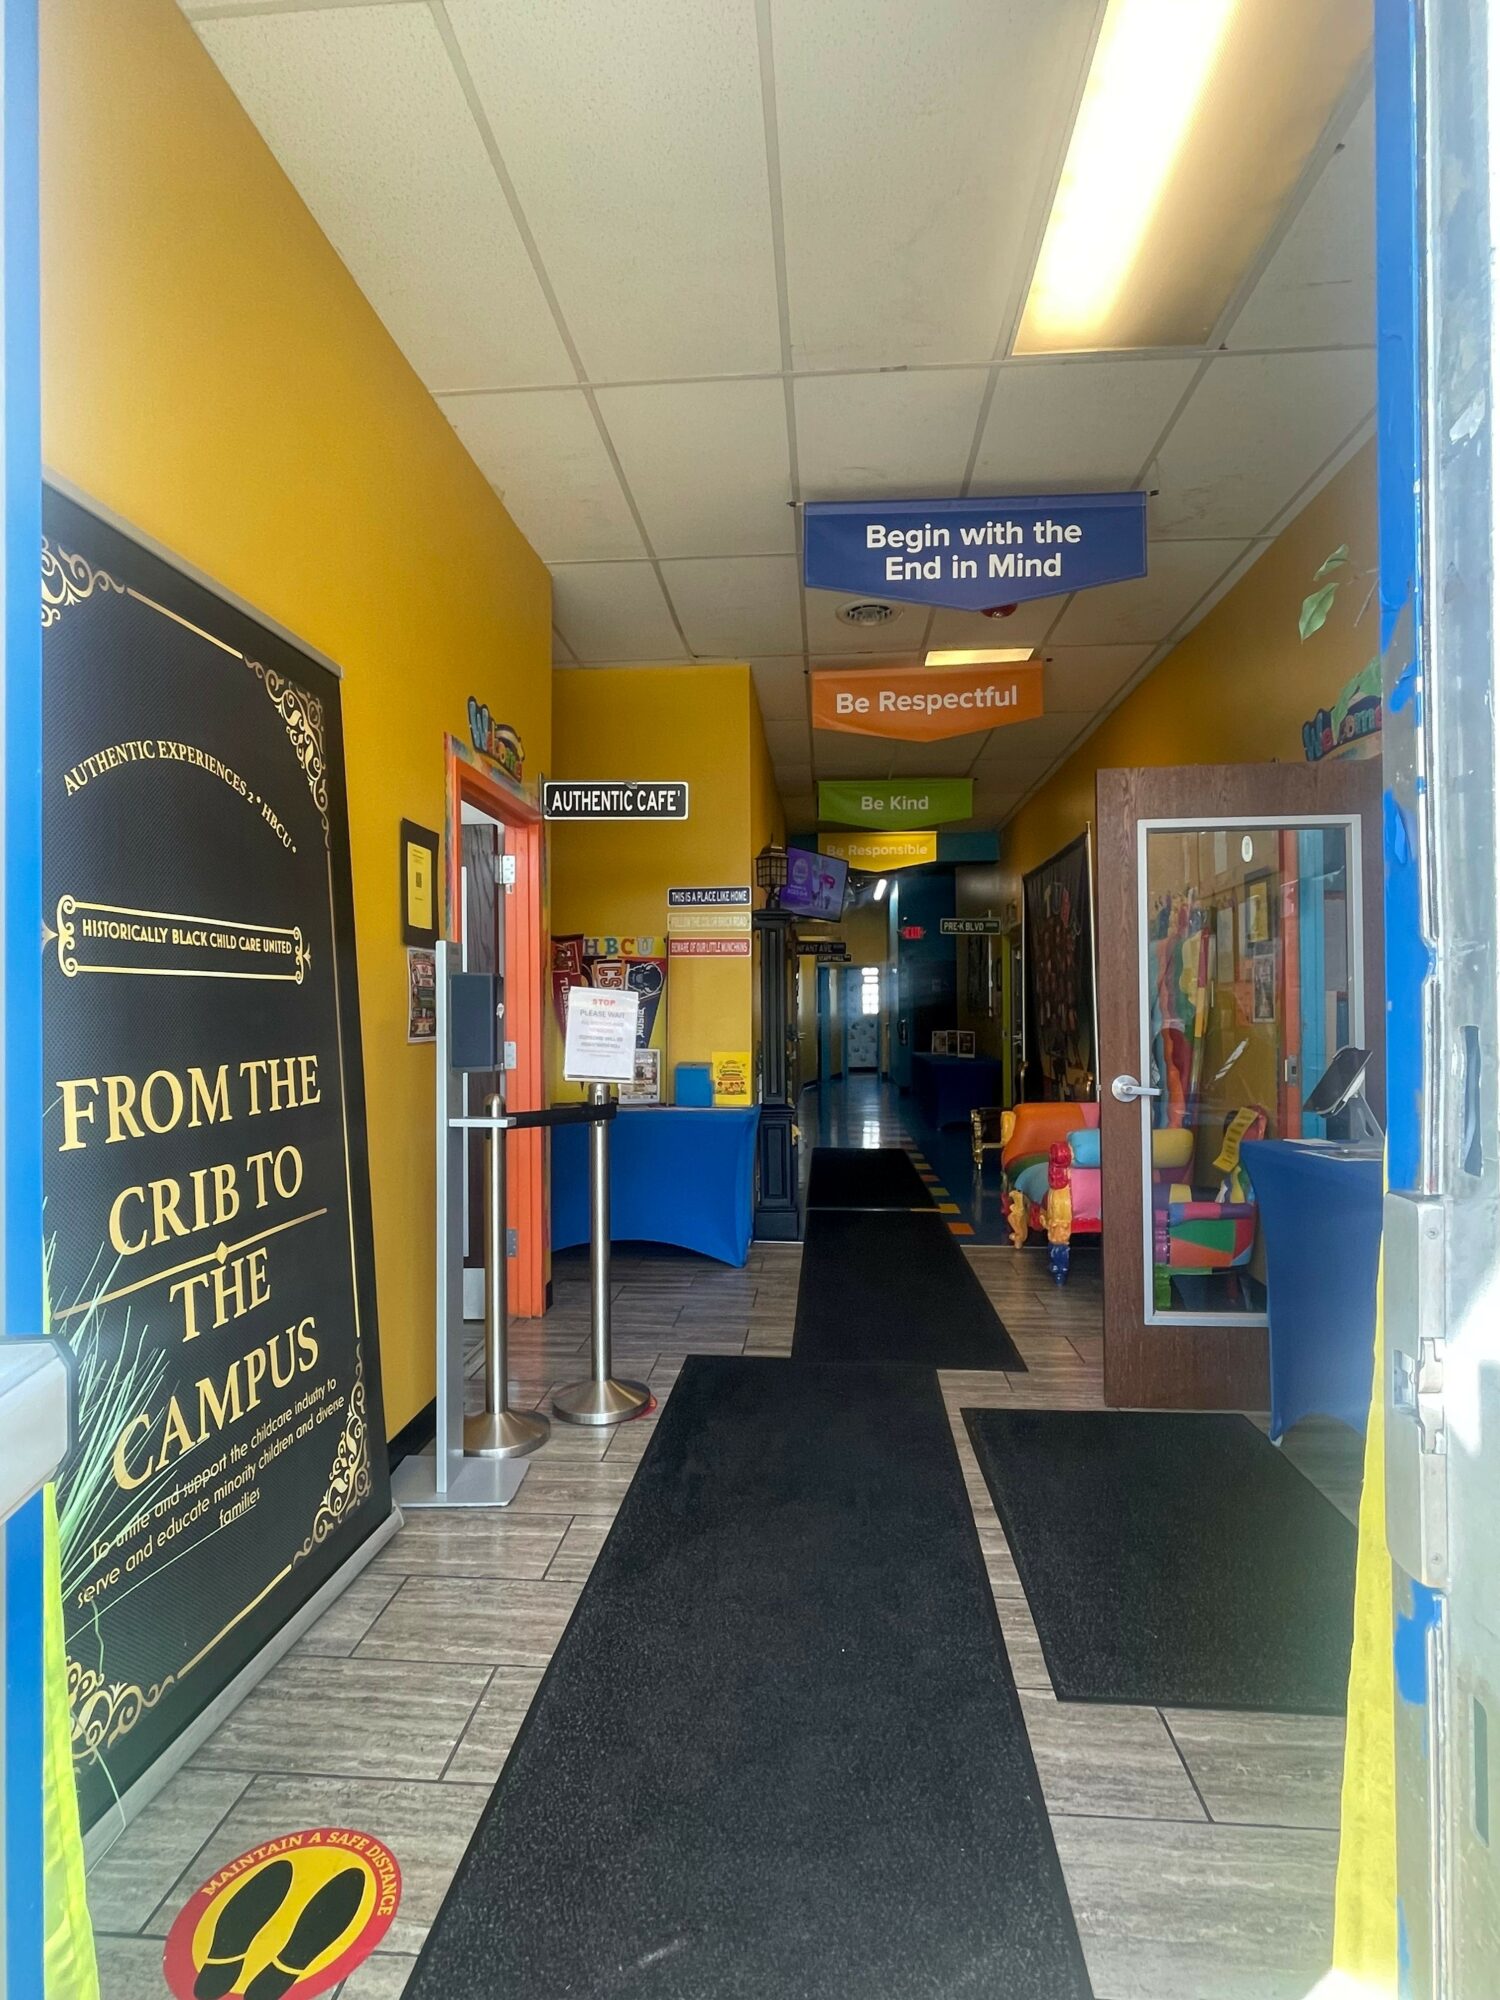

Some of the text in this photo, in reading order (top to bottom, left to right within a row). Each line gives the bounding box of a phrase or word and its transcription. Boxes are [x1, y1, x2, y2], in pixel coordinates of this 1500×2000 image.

[866, 520, 1083, 553] Begin with the
[886, 553, 1062, 581] End in Mind
[836, 685, 1018, 714] Be Respectful
[63, 740, 156, 796] AUTHENTIC
[156, 740, 247, 796] EXPERIENCES
[551, 790, 681, 812] AUTHENTIC CAFE'
[861, 796, 929, 810] Be Kind
[261, 803, 292, 848] HBCU
[827, 844, 928, 858] Be Responsible
[671, 890, 747, 903] THIS IS A PLACE LIKE HOME
[82, 918, 292, 954] HISTORICALLY BLACK CHILD CARE UNITED
[943, 922, 966, 931] PRE-K
[966, 922, 984, 931] BLVD
[584, 938, 653, 956] HBCU
[706, 942, 721, 953] LITTLE
[580, 1009, 624, 1019] PLEASE WAIT
[592, 998, 616, 1006] STOP
[56, 1055, 321, 1152] FROM THE
[108, 1145, 304, 1255] CRIB TO
[169, 1247, 272, 1343] THE
[113, 1316, 320, 1490] CAMPUS
[154, 1483, 180, 1518] and
[183, 1453, 227, 1498] support
[230, 1443, 249, 1464] the
[250, 1408, 293, 1449] childcare
[294, 1385, 326, 1415] industry
[327, 1378, 337, 1394] to
[77, 1396, 345, 1609] serve and educate minority children and diverse
[218, 1487, 261, 1528] families
[200, 1831, 397, 1916] MAINTAIN A SAFE DISTANCE
